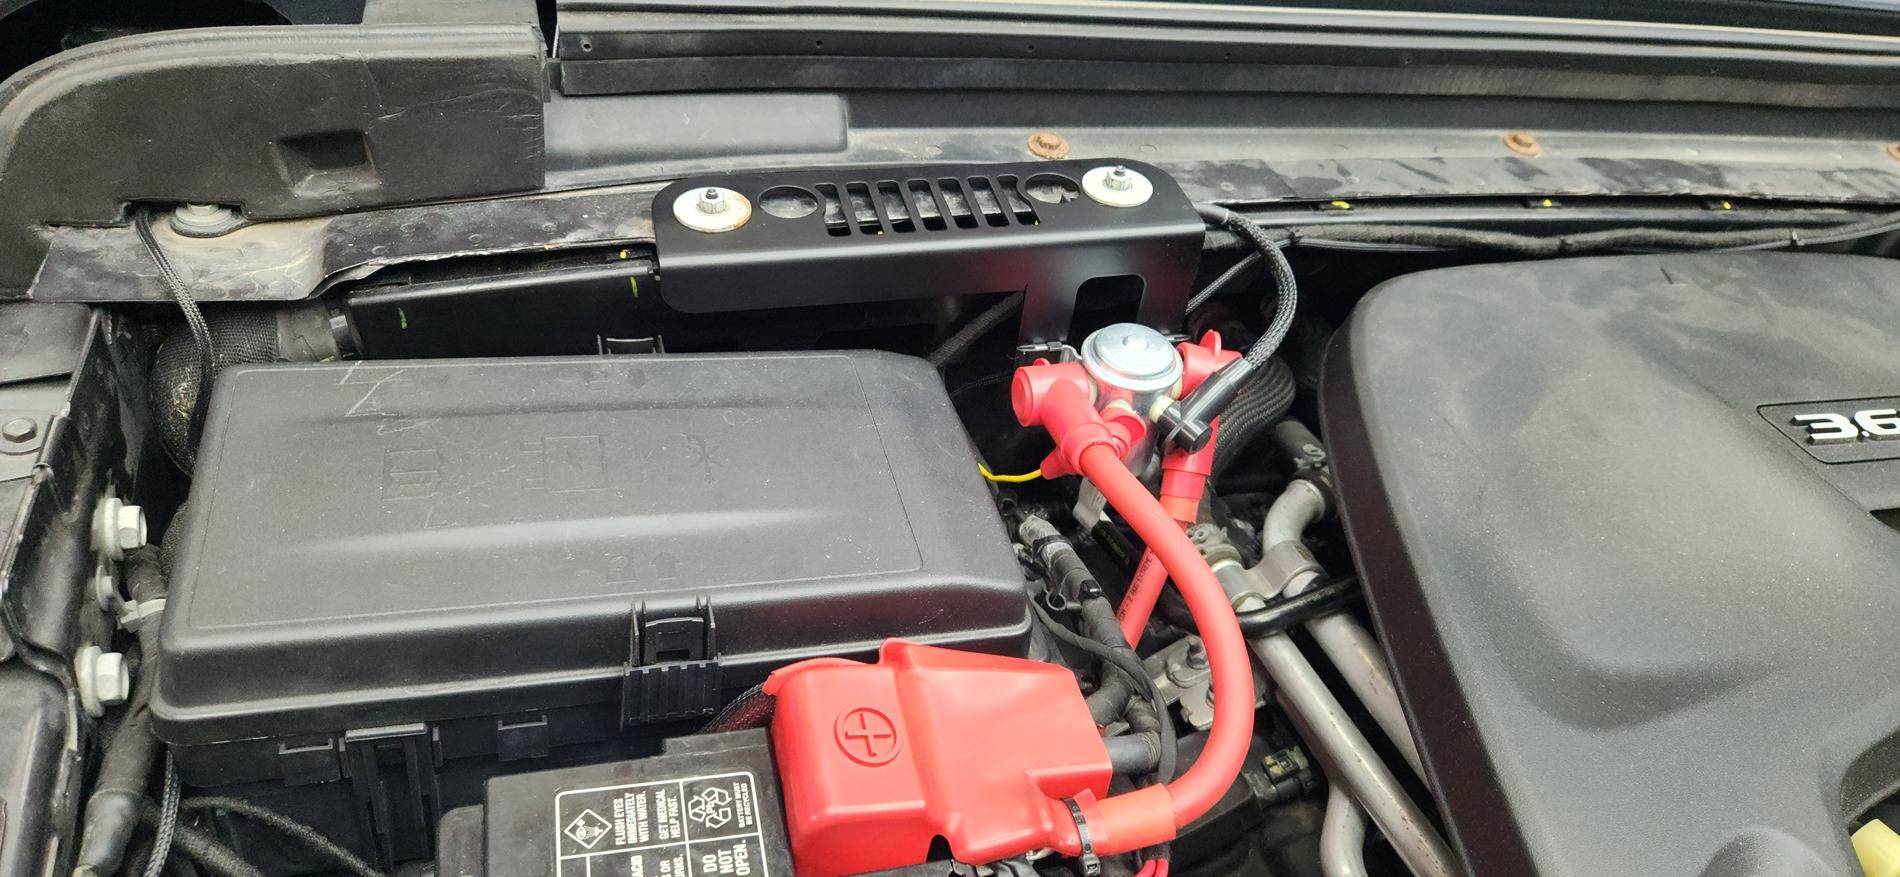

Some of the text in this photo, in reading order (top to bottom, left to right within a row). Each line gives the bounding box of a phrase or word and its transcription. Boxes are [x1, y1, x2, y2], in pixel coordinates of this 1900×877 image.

[613, 798, 627, 846] FLUSH EYES
[624, 792, 638, 844] IMMEDIATELY
[635, 790, 650, 843] WITH WATER.
[655, 788, 670, 840] GET MEDICAL
[667, 795, 681, 838] HELP FAST.
[732, 782, 746, 828] BATTERY MUST
[741, 783, 753, 826] BE RECYCLED
[659, 860, 671, 873] OR
[702, 854, 718, 873] DO
[717, 849, 734, 874] NOT
[732, 839, 751, 876] OPEN.
